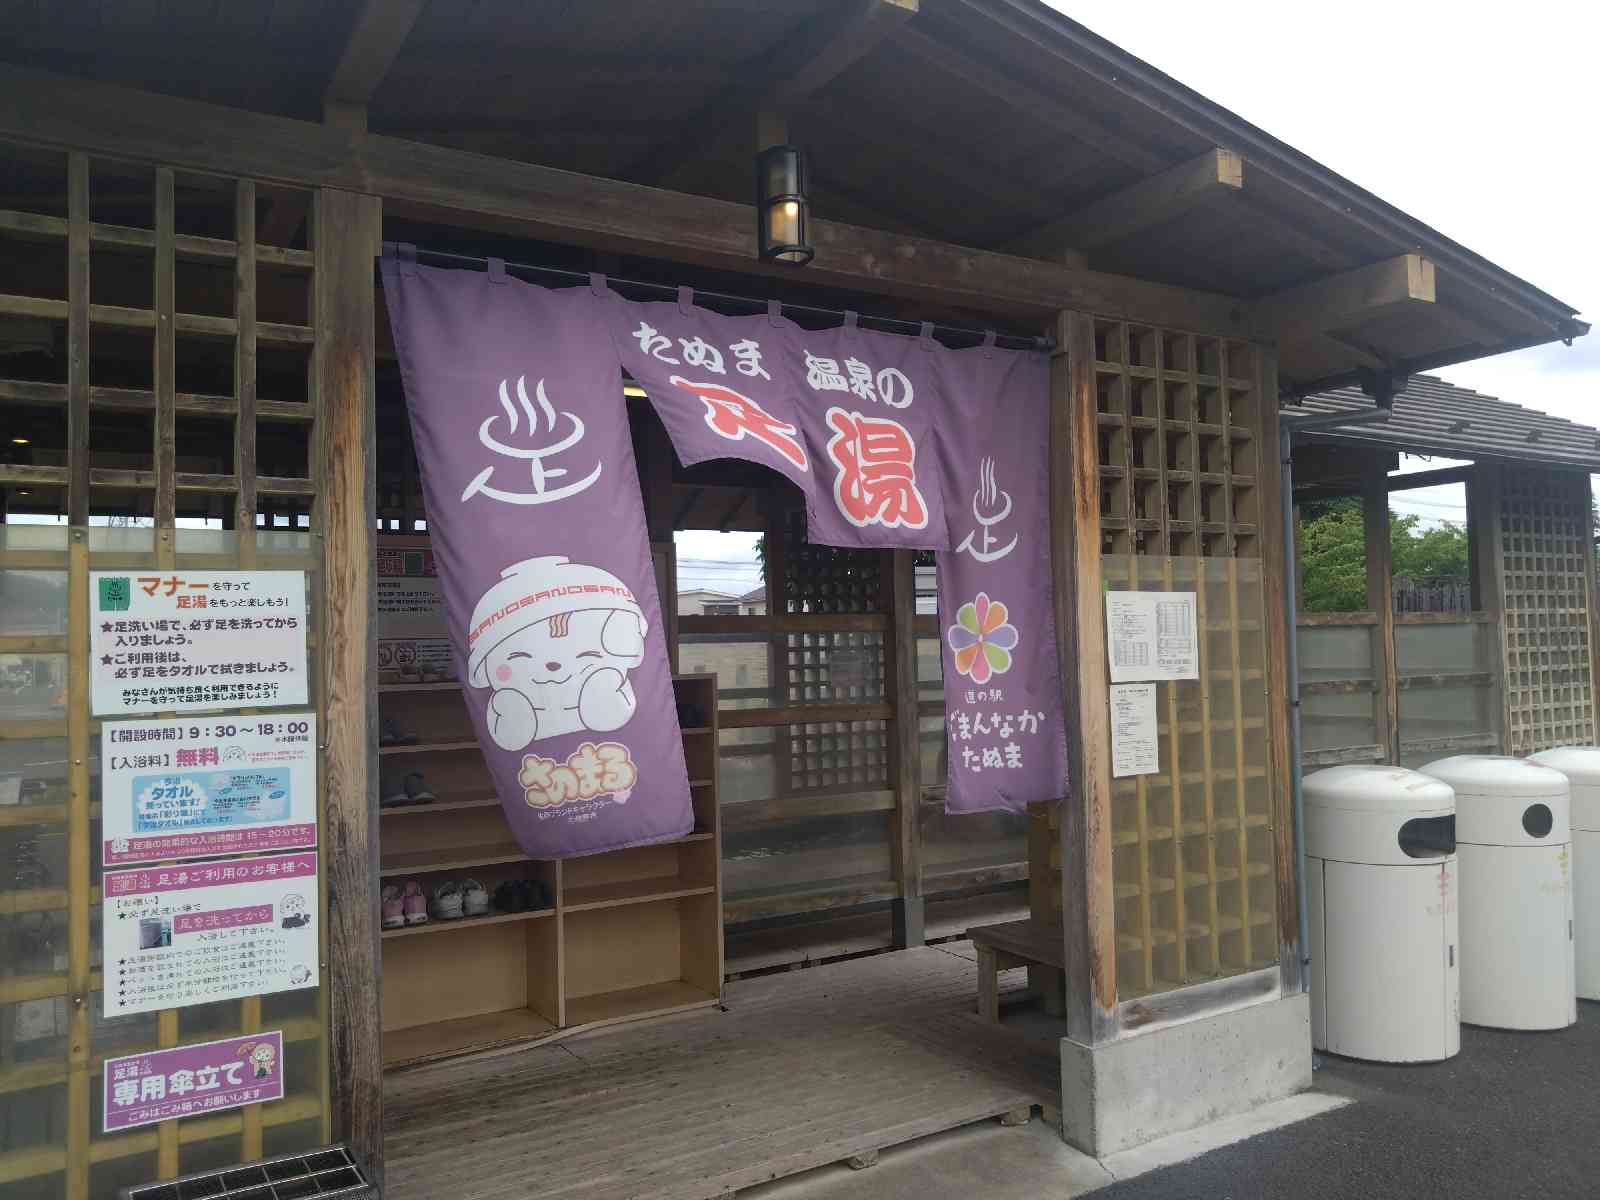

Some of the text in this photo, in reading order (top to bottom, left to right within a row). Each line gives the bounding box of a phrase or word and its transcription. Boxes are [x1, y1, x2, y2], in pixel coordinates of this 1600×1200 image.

[632, 322, 771, 381] たぬま
[825, 407, 928, 529] 湯
[137, 576, 209, 597] マナー
[213, 581, 250, 591] を守って
[176, 595, 208, 609] 足湯
[115, 634, 193, 647] 入りましょう。
[965, 689, 1004, 704] 道の駅
[176, 747, 219, 767] 無料
[962, 742, 1023, 772] たぬま
[520, 743, 636, 807] さのまる
[151, 785, 193, 800] タオル
[113, 1061, 245, 1106] 専用傘立て
